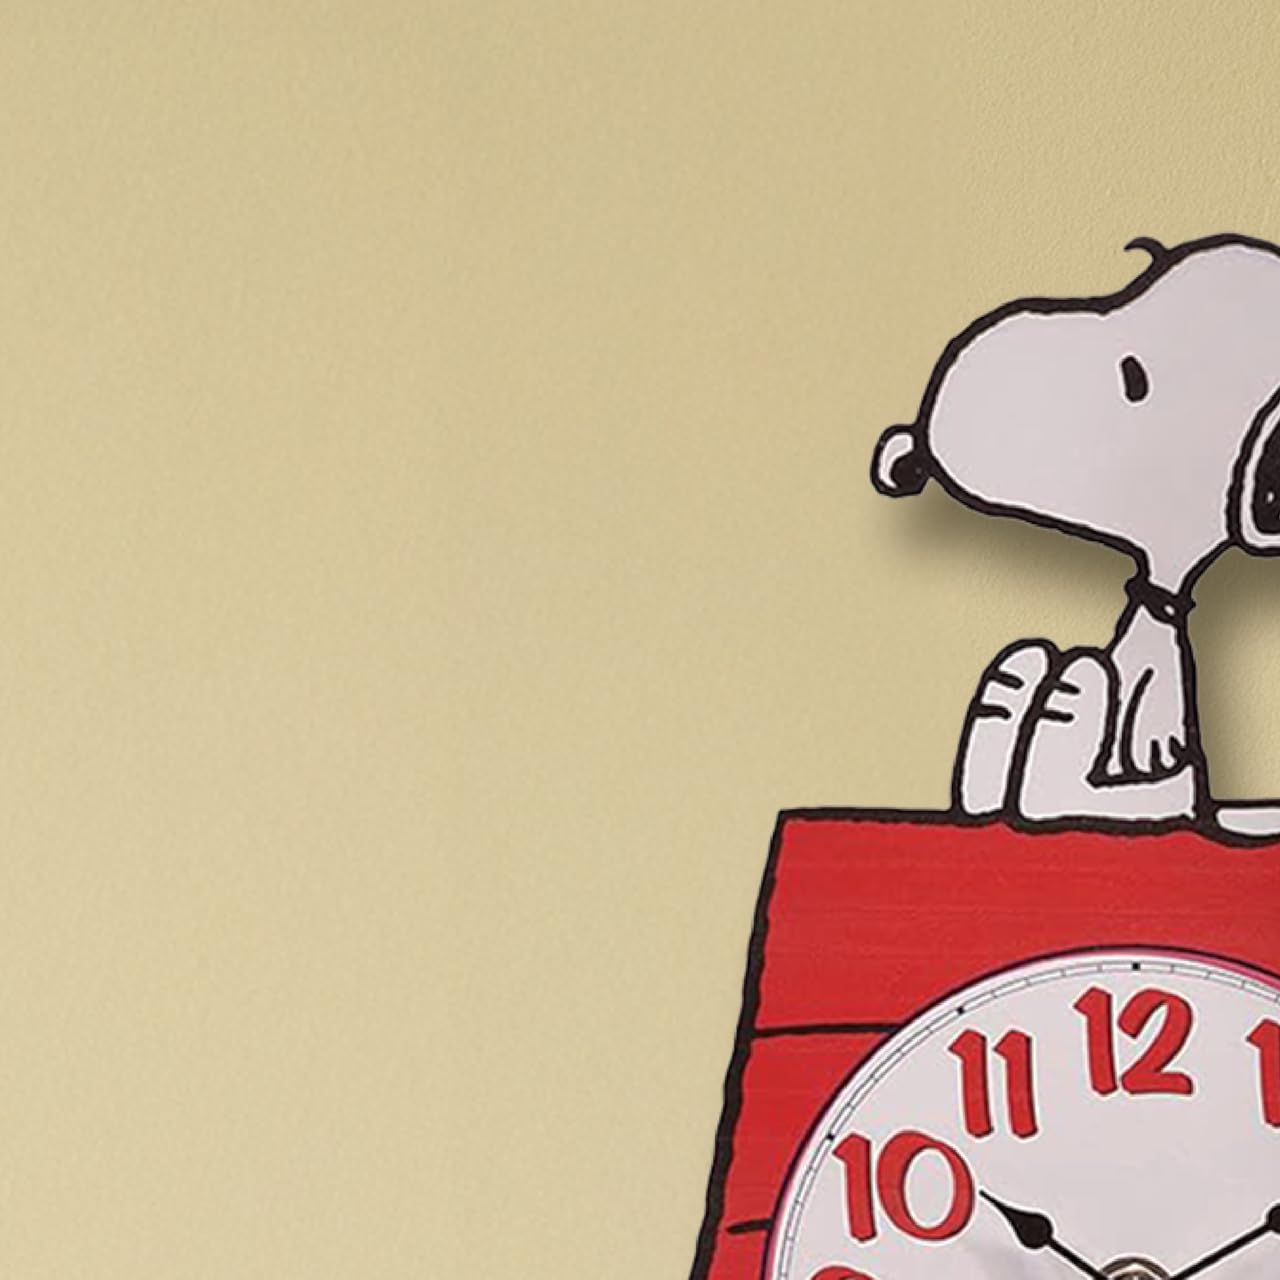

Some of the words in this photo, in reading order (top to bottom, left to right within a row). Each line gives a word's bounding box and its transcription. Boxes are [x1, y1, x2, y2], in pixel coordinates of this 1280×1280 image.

[949, 1029, 1037, 1138] 11
[1074, 986, 1192, 1096] 12
[833, 1130, 974, 1241] 10
